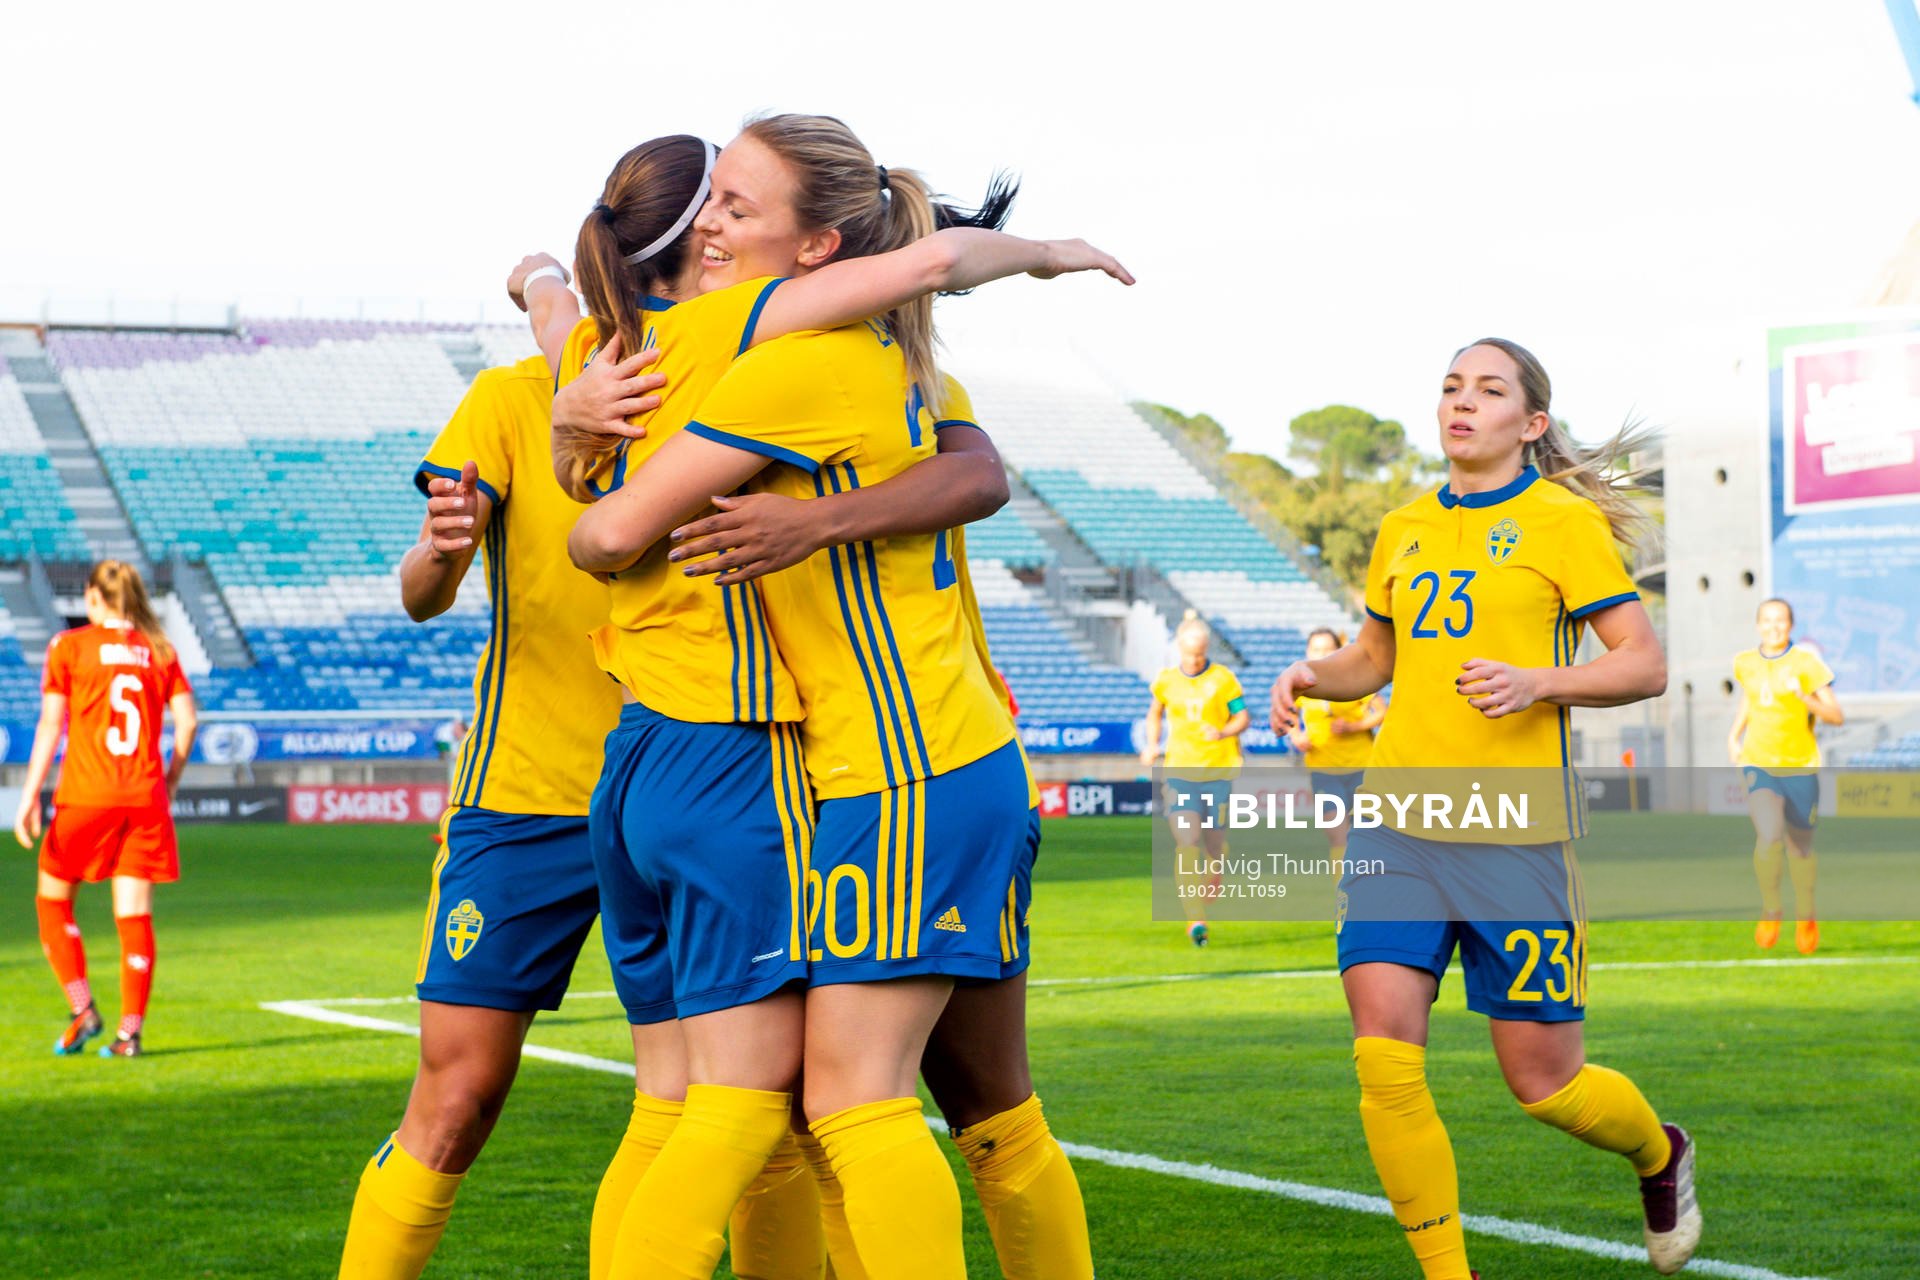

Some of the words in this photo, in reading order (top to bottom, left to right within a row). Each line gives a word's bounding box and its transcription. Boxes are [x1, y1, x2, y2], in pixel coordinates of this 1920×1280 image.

[1410, 570, 1477, 639] 23
[106, 673, 143, 757] 5
[281, 732, 372, 754] ALGARVE
[374, 731, 416, 752] CUP
[1062, 727, 1100, 747] CUP
[322, 789, 409, 821] SAGRES
[1067, 784, 1114, 815] BPI
[933, 920, 967, 933] adidas
[1504, 928, 1572, 1003] 23
